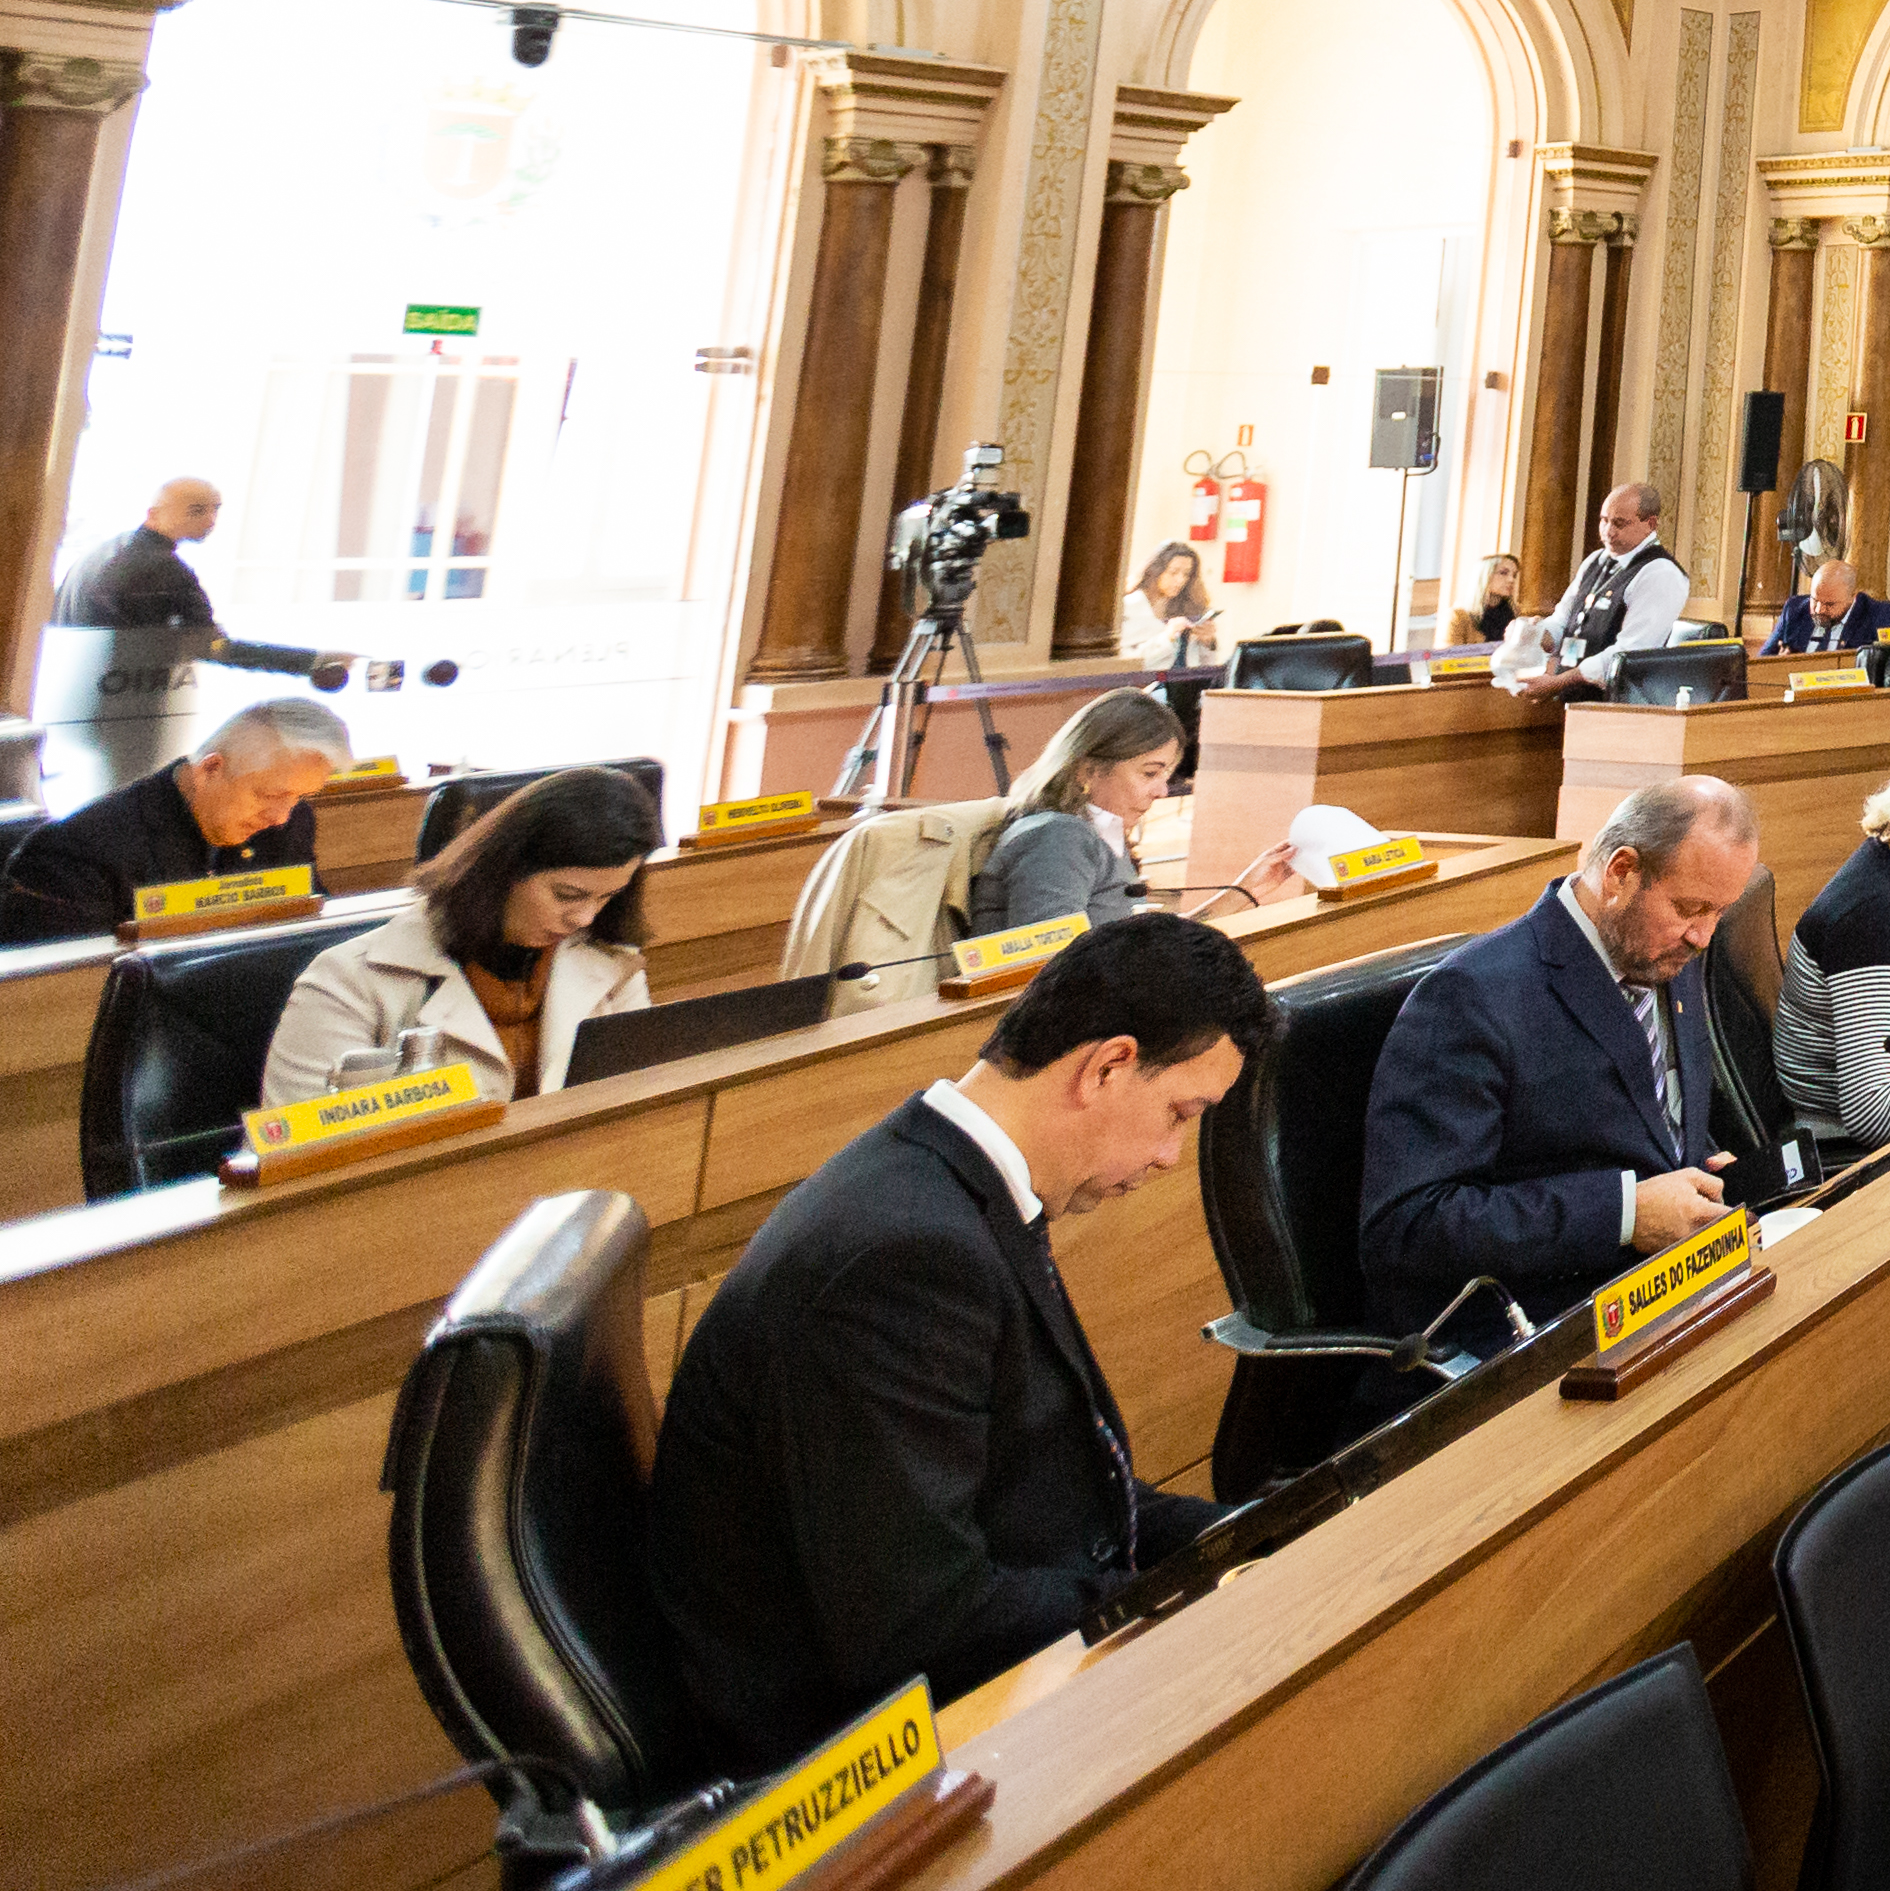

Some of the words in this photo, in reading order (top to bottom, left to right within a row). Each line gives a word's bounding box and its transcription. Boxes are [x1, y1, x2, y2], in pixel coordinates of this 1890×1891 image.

[404, 310, 475, 331] SAÍDA
[318, 1096, 381, 1126] INDIARA
[383, 1079, 453, 1110] BARBOSA
[1629, 1271, 1668, 1316] SALLES
[1669, 1262, 1684, 1292] DO
[1685, 1224, 1745, 1282] FAZENDINHA
[730, 1718, 922, 1889] PETRUZZIELLO
